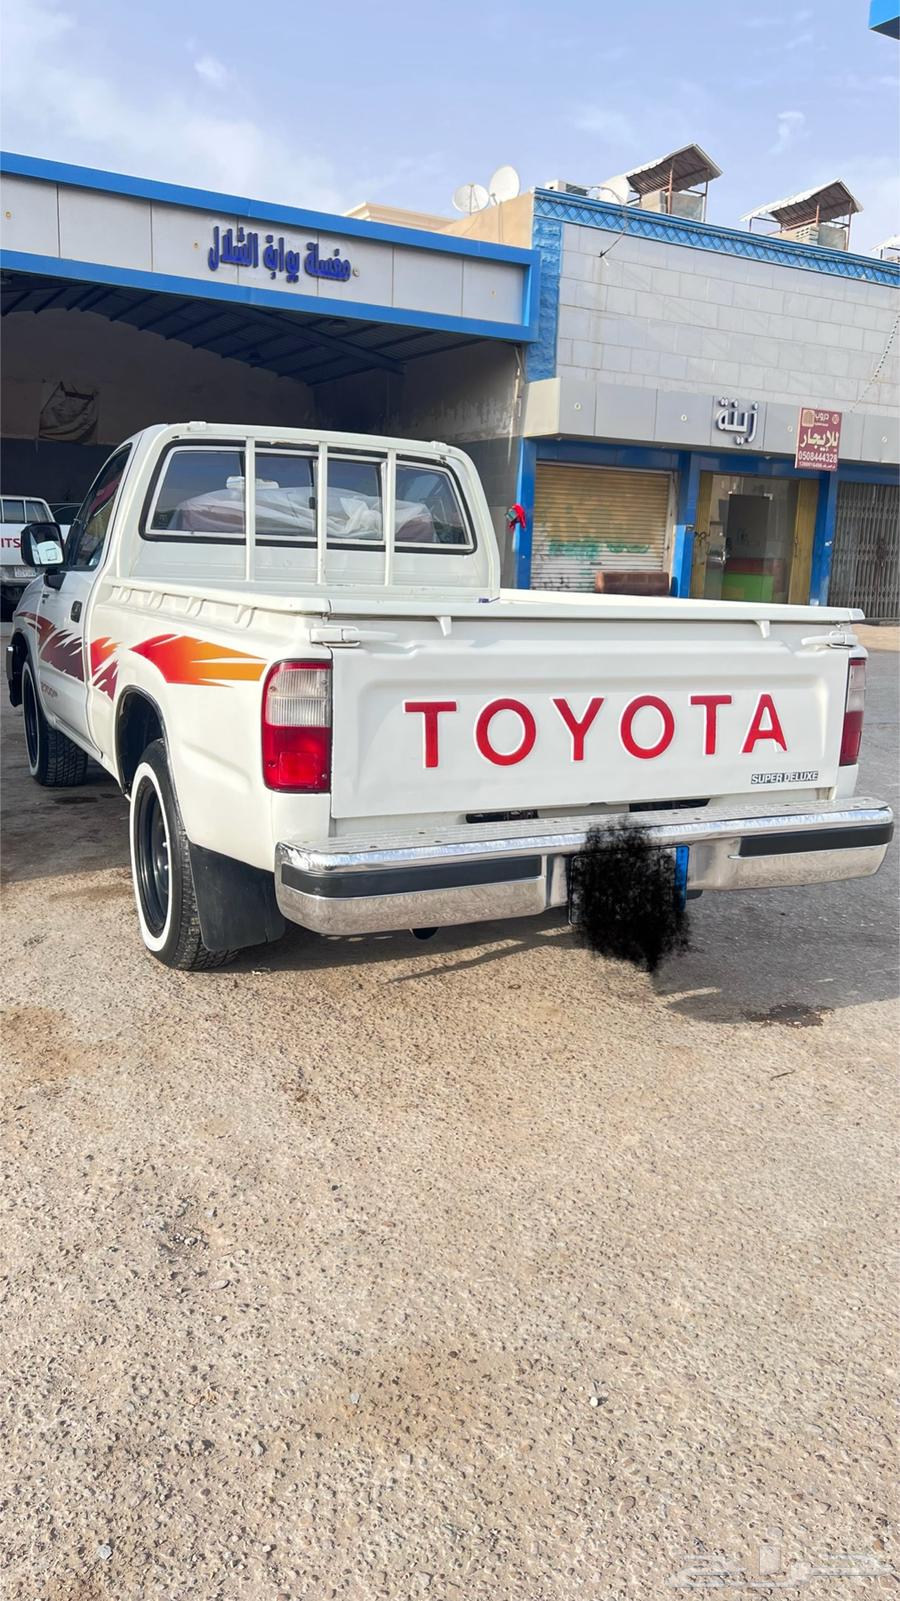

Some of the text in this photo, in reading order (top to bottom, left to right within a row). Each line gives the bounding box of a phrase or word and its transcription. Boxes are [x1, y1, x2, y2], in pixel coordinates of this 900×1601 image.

[208, 225, 259, 272] الشلال
[304, 242, 351, 282] مغسلة
[716, 398, 759, 445] زينة
[403, 693, 789, 768] TOYOTA
[751, 771, 818, 784] SUPER DELUXE
